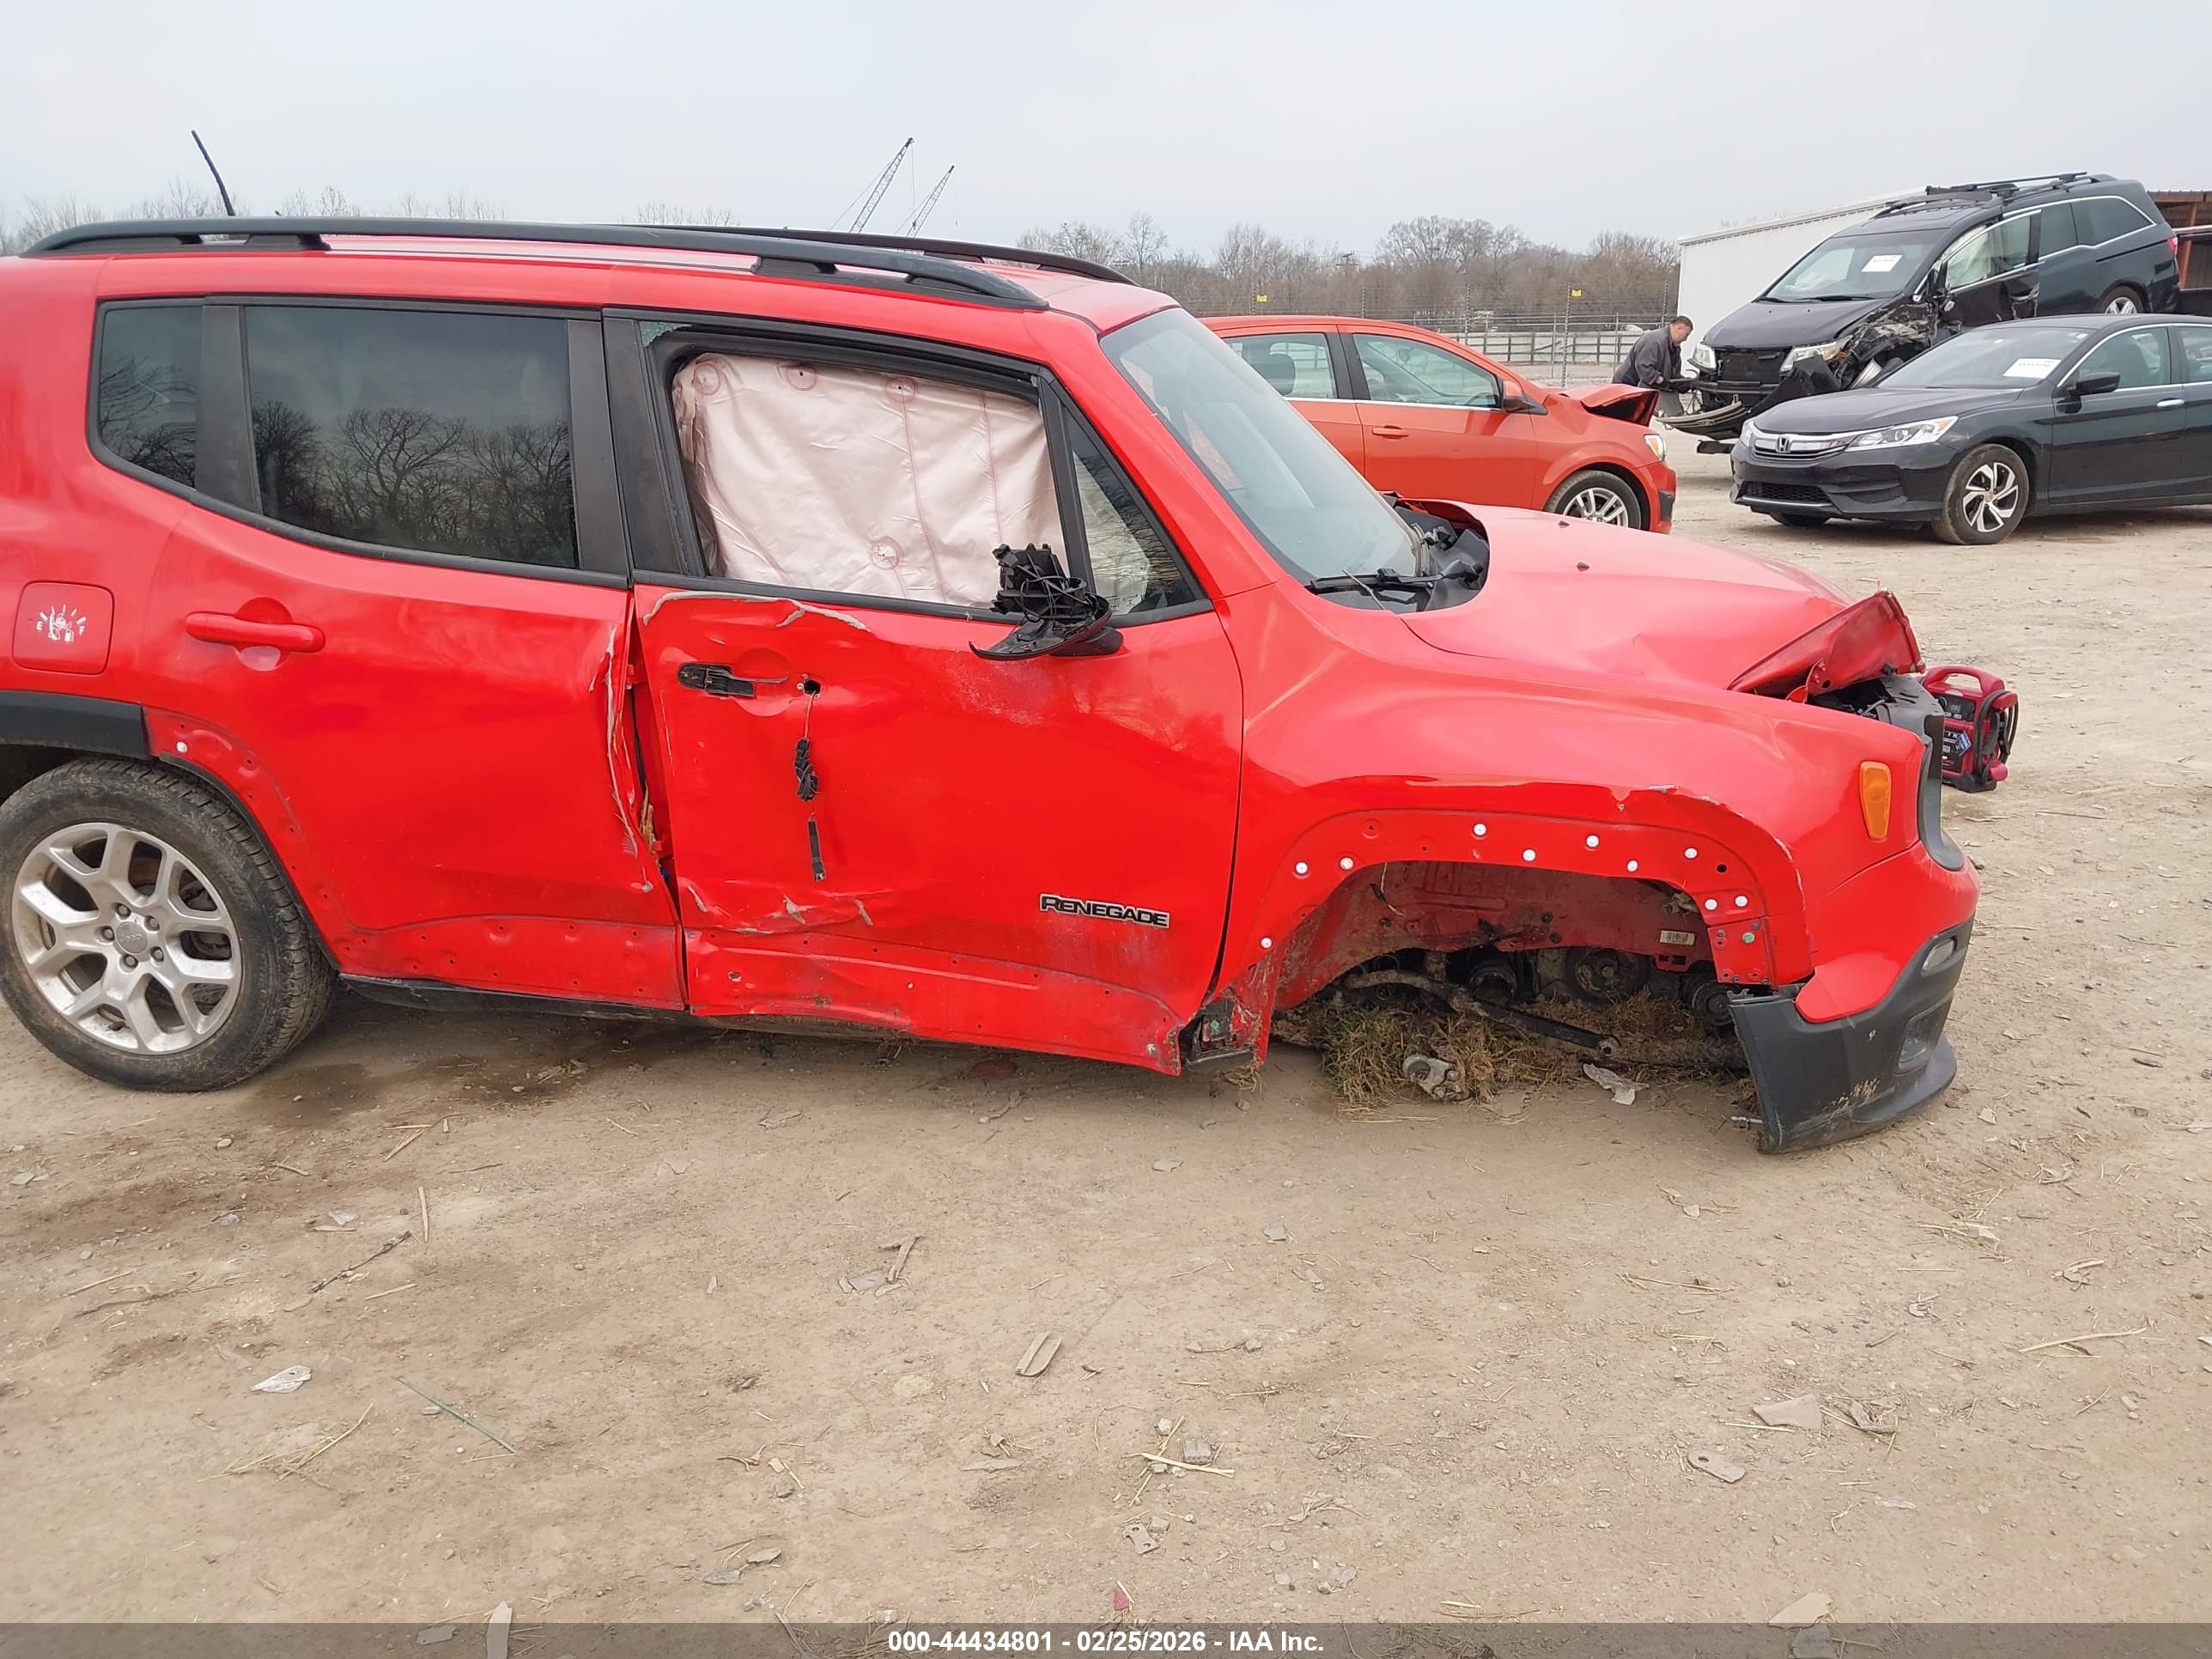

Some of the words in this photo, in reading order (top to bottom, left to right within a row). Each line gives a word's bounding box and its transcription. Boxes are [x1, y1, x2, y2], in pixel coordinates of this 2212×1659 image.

[36, 621, 44, 631] E
[79, 626, 86, 635] F
[1041, 895, 1169, 927] RENEGADE
